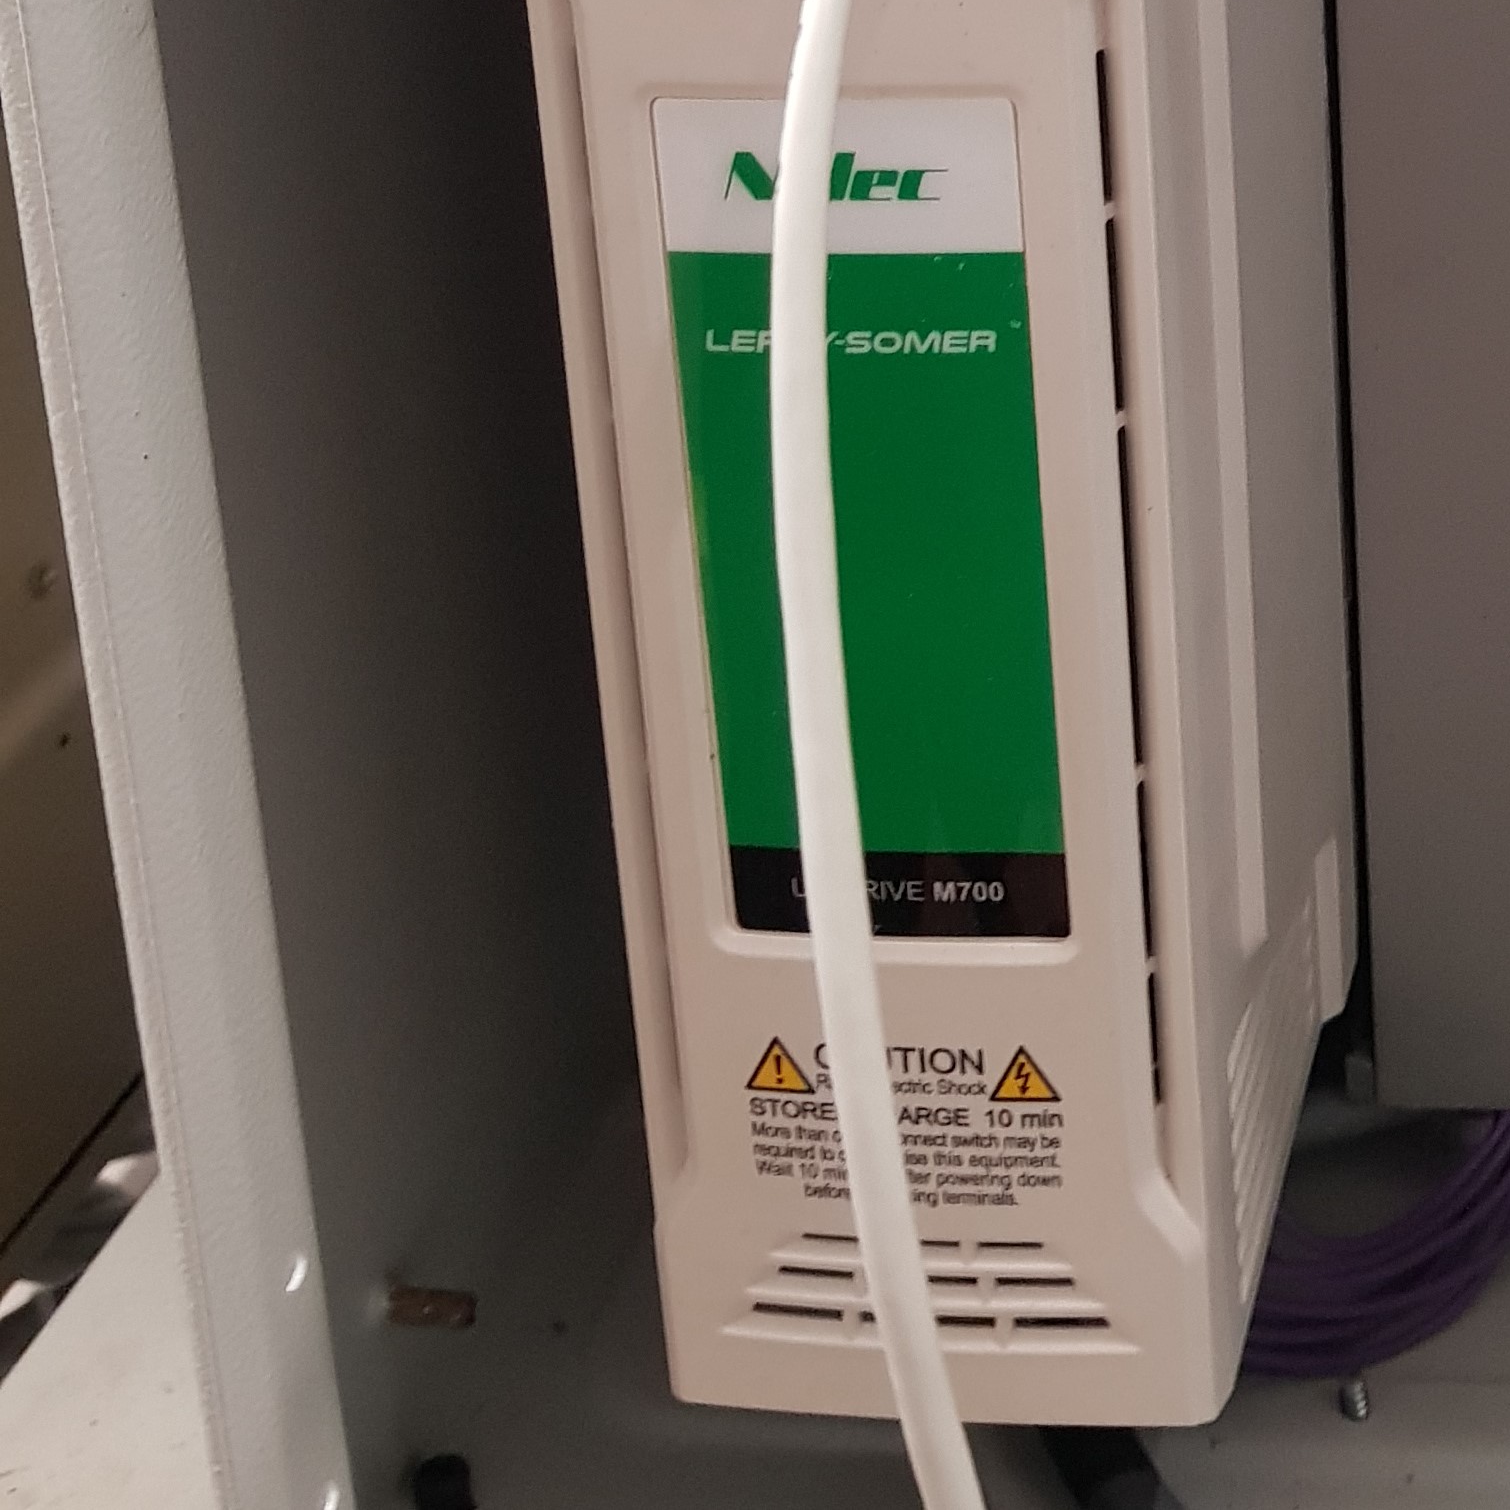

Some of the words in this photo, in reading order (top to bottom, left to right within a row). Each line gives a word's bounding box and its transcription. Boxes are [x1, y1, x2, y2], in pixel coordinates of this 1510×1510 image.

[724, 151, 950, 201] Nec
[932, 880, 1005, 903] M700
[936, 1078, 988, 1096] Shock
[984, 1108, 1013, 1128] 10
[1020, 1108, 1065, 1128] min
